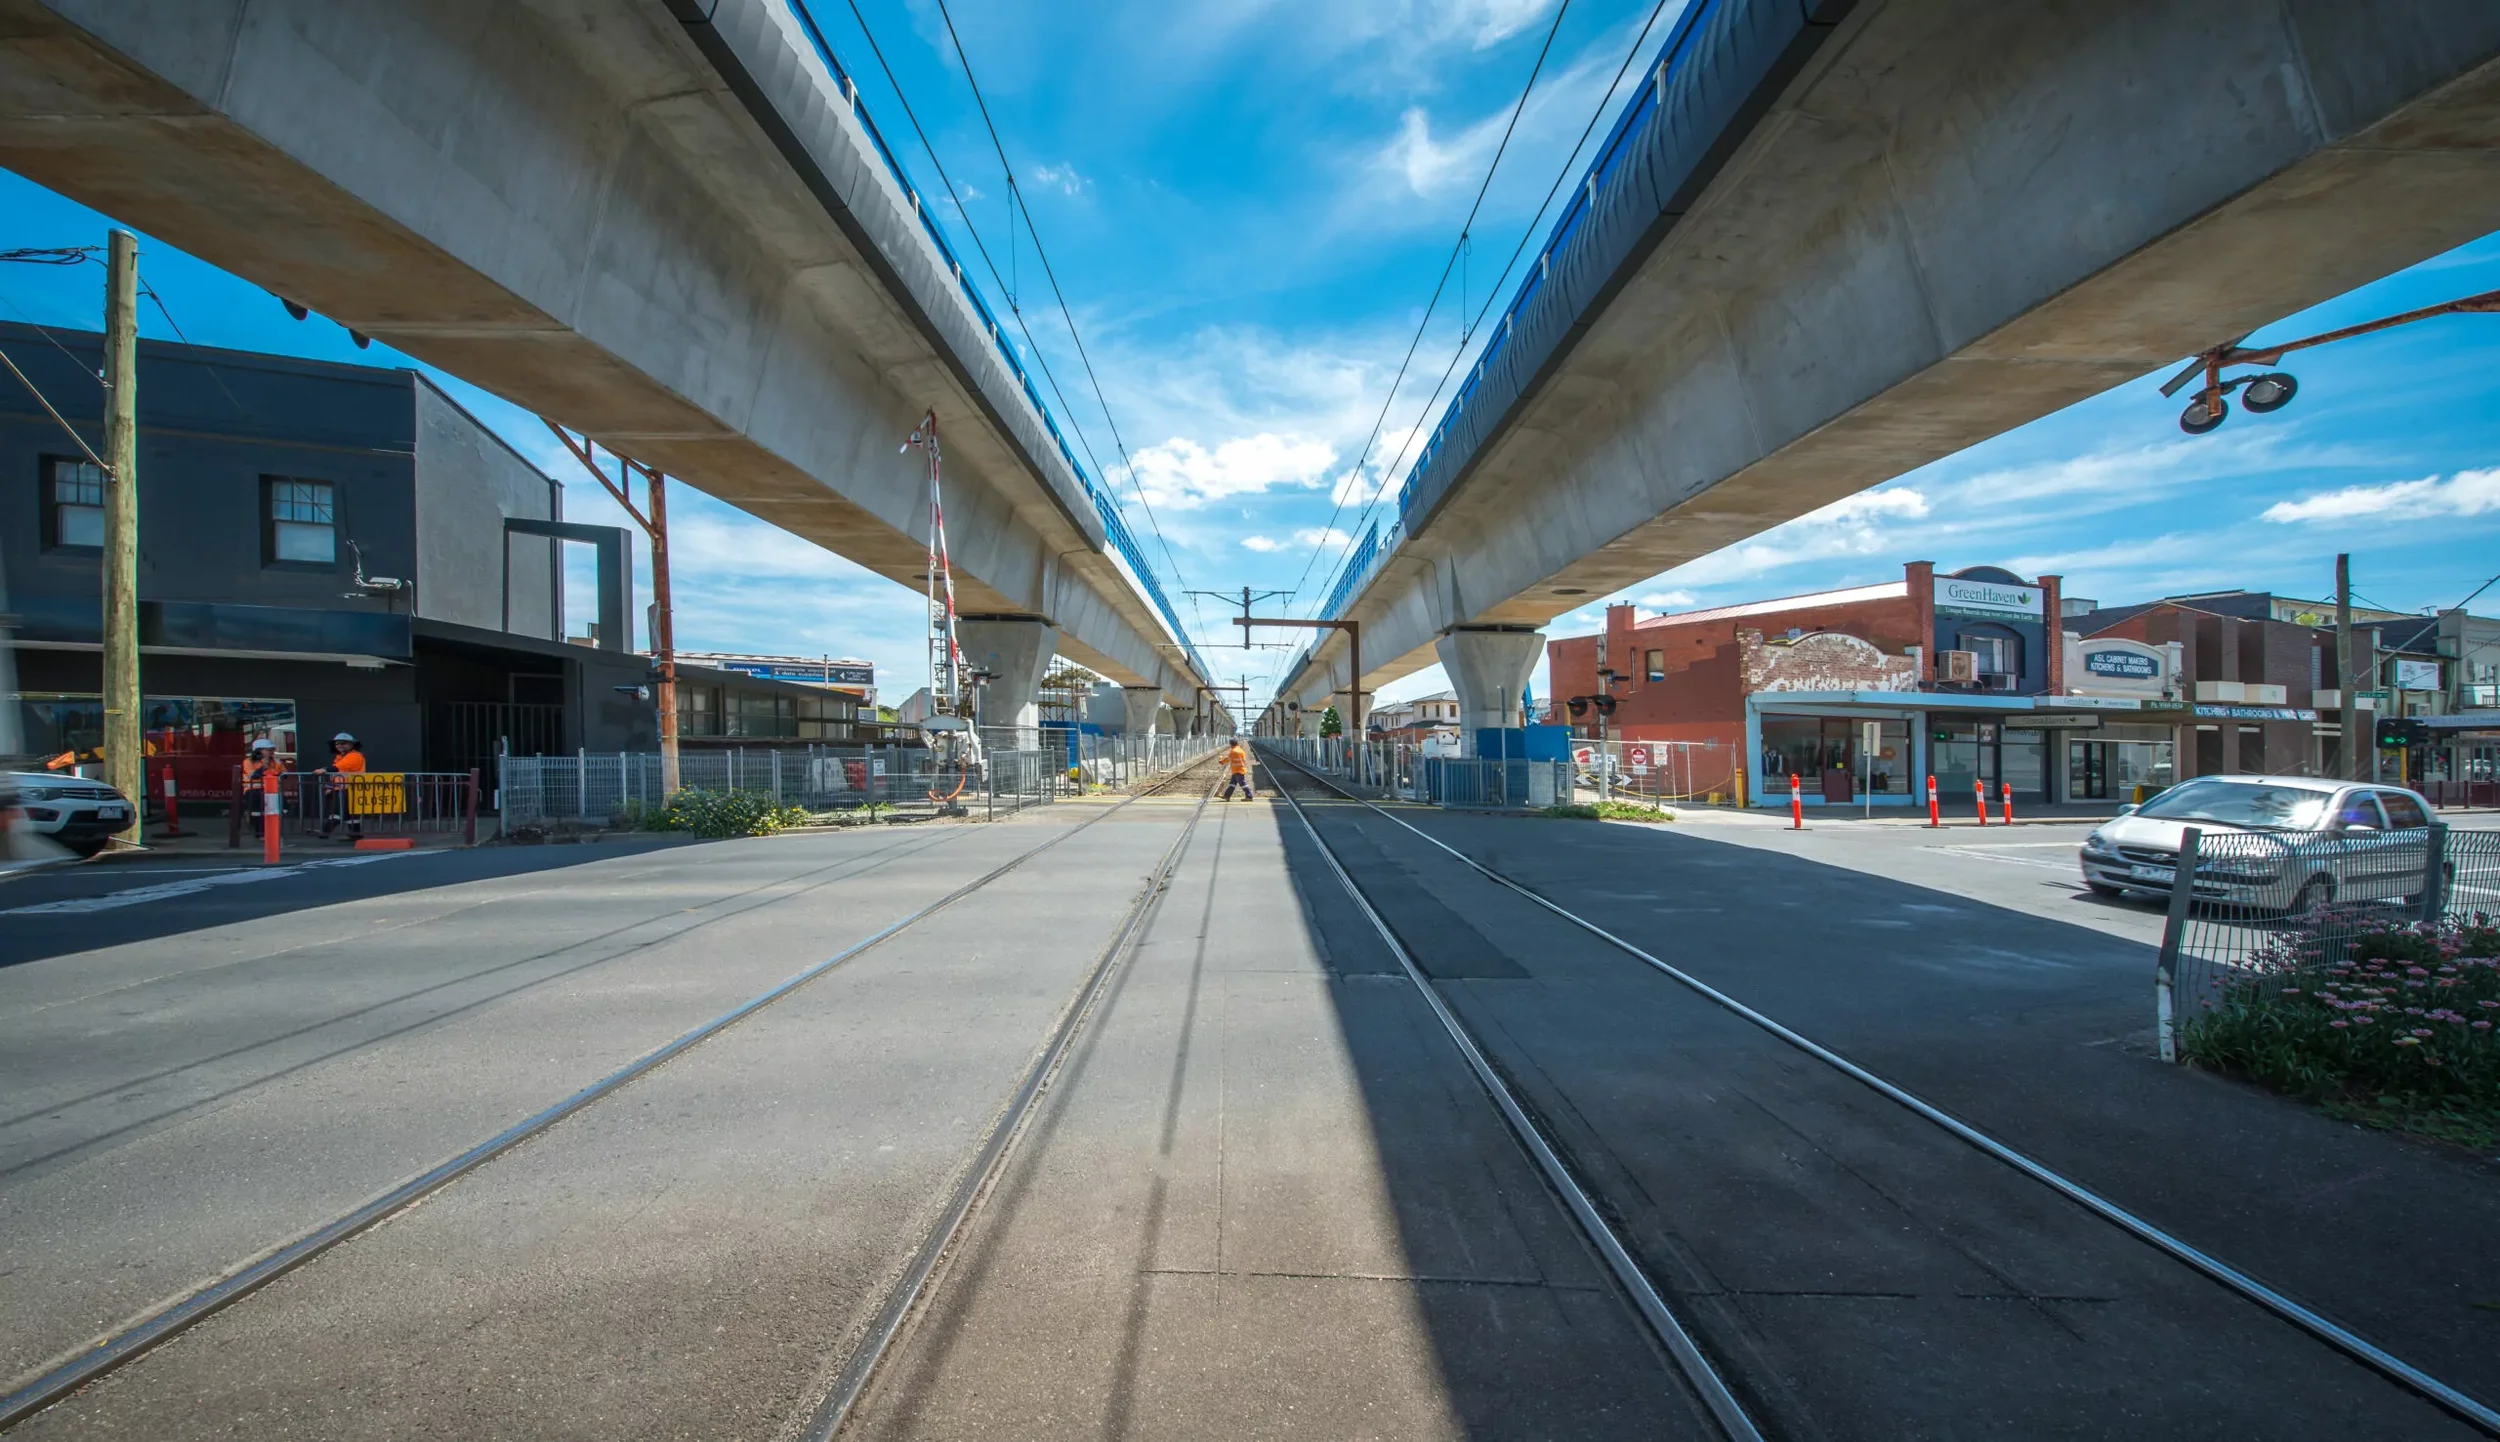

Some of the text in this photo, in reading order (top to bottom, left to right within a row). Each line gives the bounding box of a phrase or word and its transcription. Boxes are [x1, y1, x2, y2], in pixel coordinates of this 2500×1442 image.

[1948, 584, 2016, 604] GreenHaven
[2094, 654, 2149, 666] ASL CABINET MAKERS
[2090, 662, 2115, 672] KITCHENS
[2122, 664, 2152, 674] BATHROOMS
[2231, 708, 2272, 718] BATHROOMS
[357, 796, 397, 806] CLOSED
